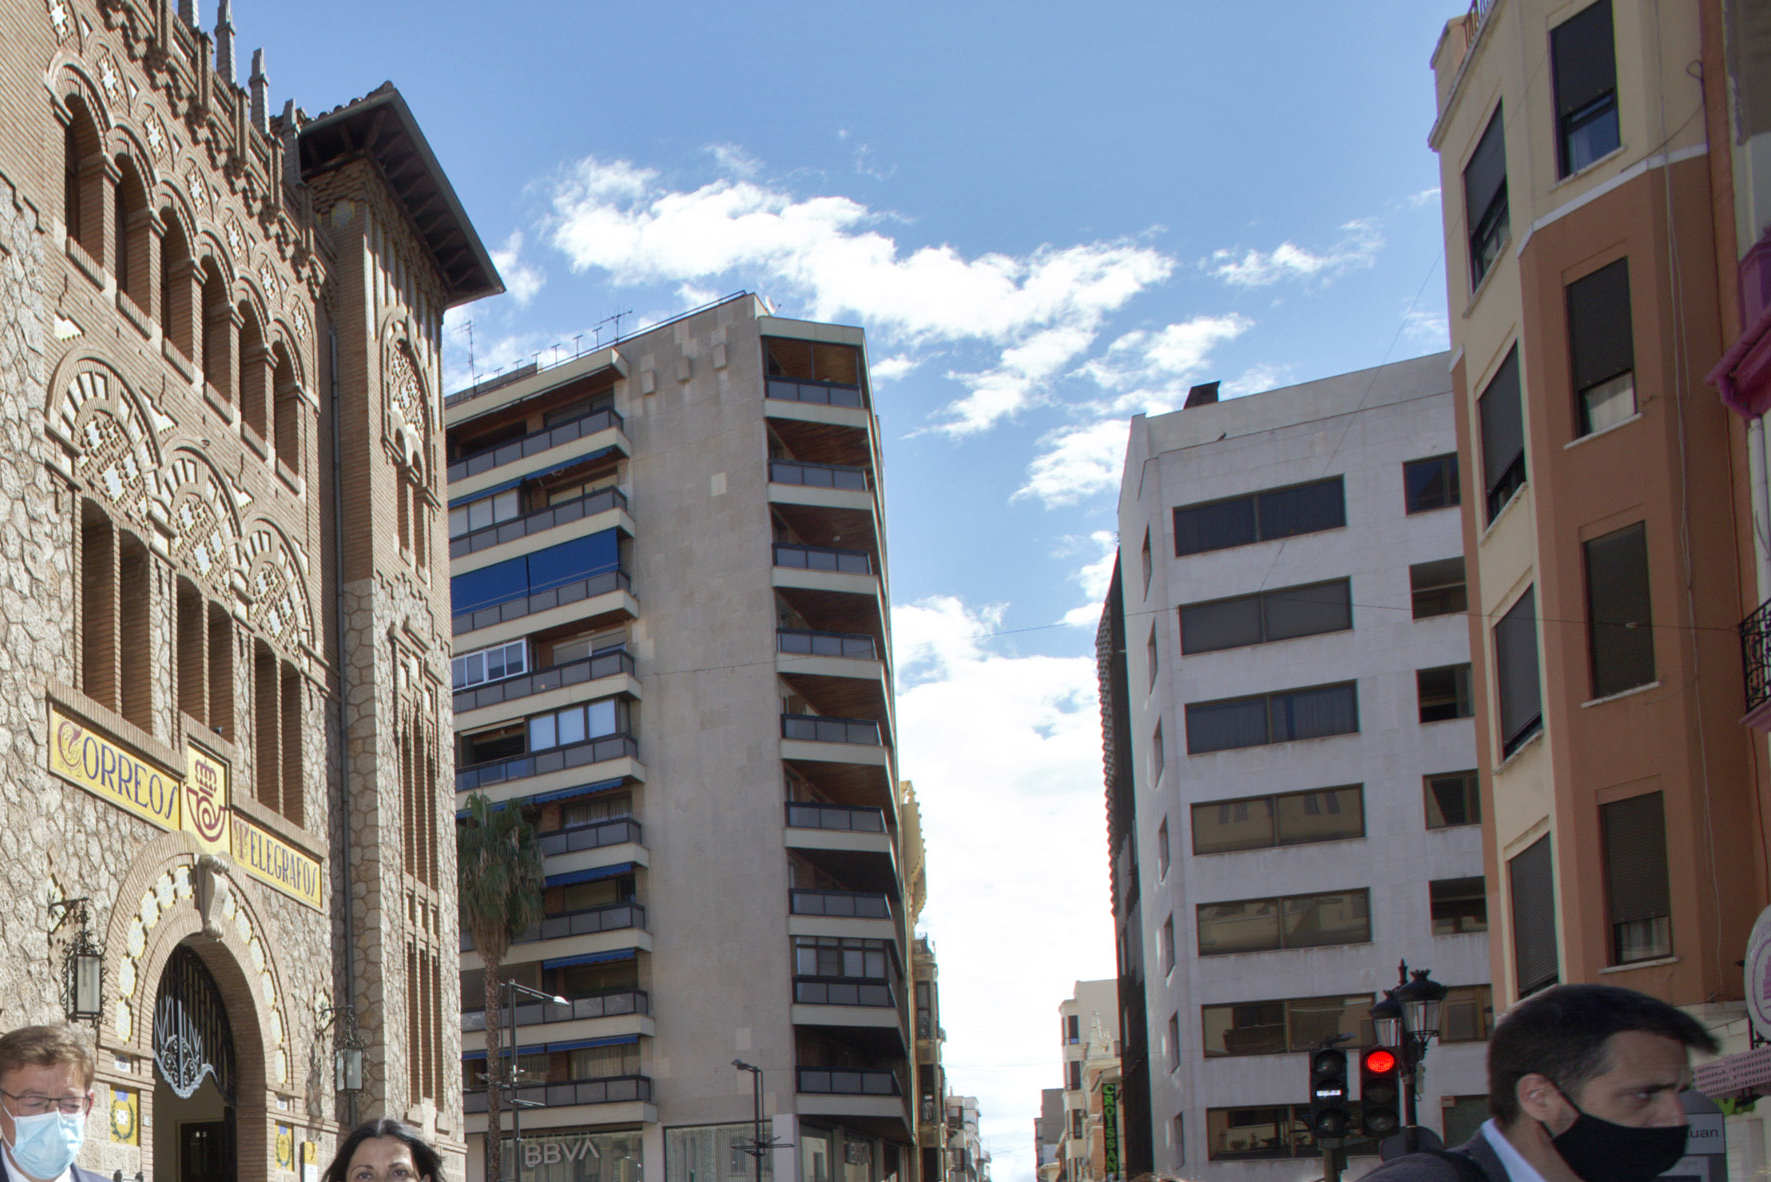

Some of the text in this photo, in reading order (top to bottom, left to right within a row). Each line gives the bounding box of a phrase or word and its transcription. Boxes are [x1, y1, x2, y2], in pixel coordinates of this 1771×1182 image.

[57, 720, 178, 820] CORREOS
[233, 819, 317, 898] TELEGRAFOS
[525, 1139, 600, 1168] BBVA
[1687, 1128, 1719, 1139] uan
